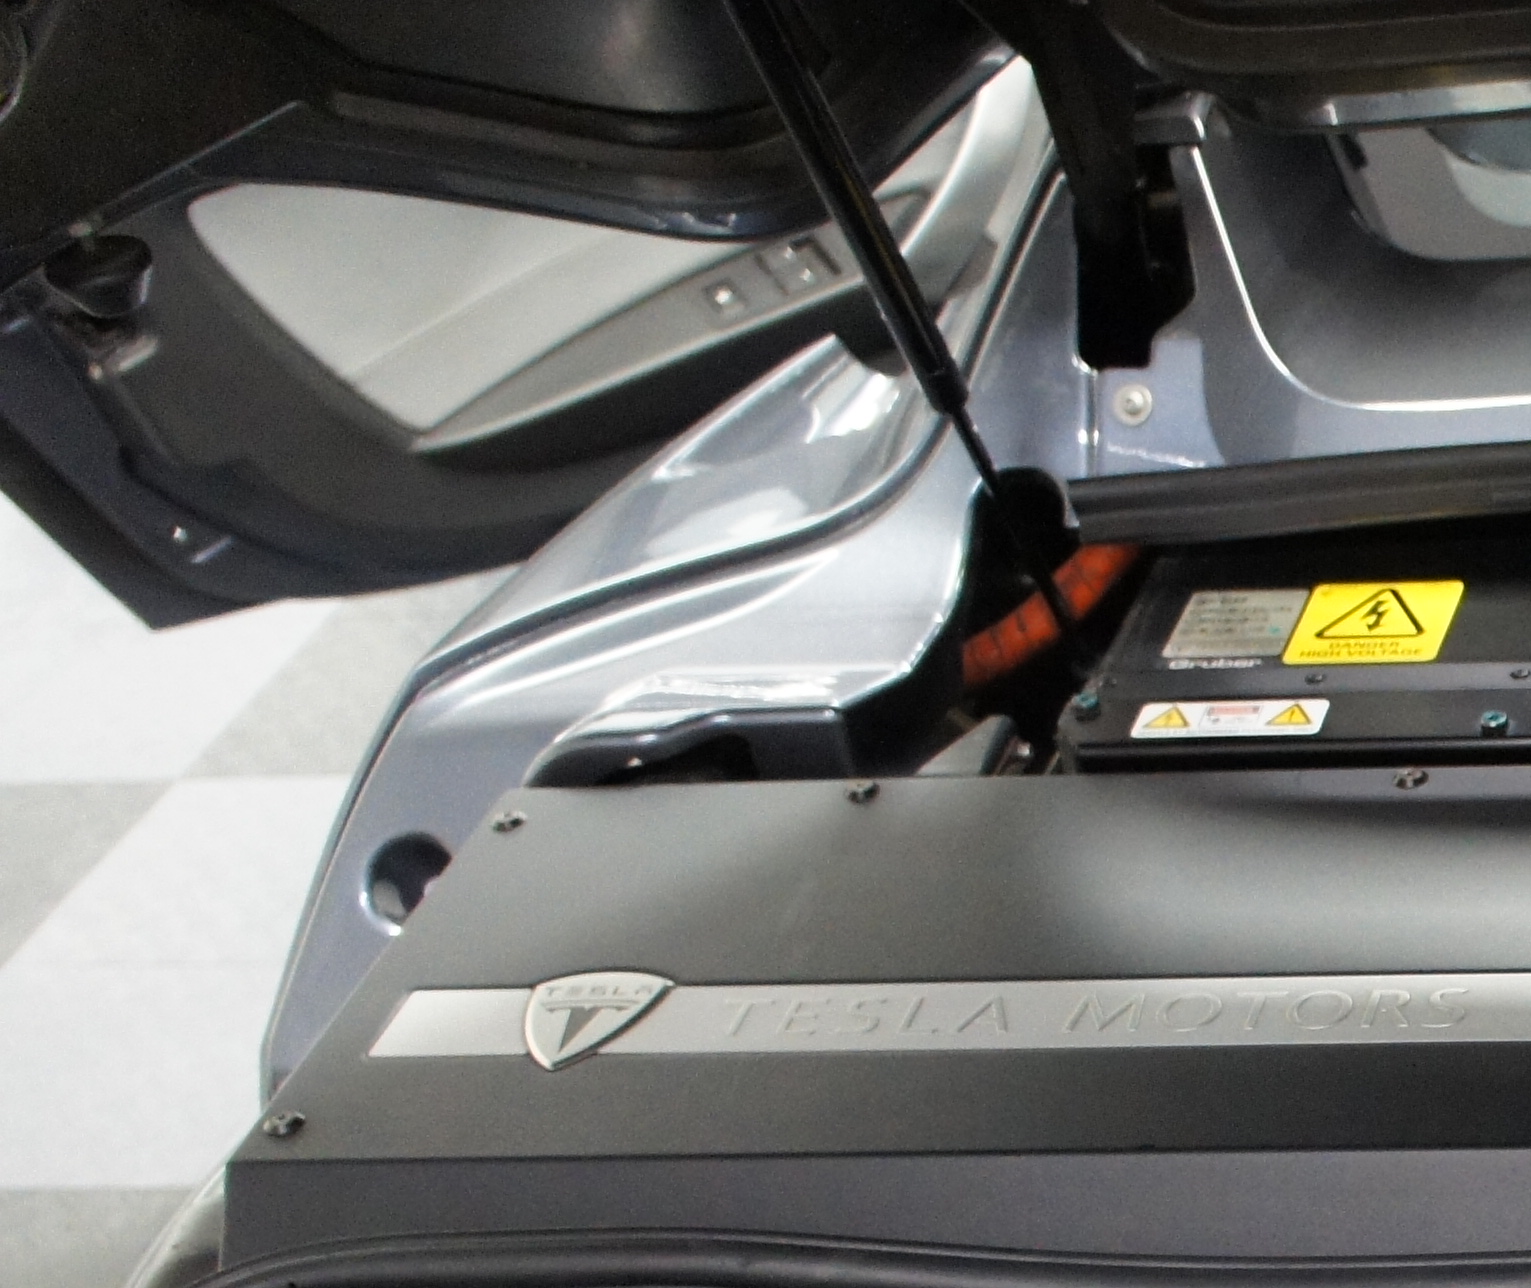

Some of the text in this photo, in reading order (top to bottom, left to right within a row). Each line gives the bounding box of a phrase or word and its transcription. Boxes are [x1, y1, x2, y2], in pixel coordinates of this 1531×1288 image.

[1328, 641, 1400, 650] DANGER
[544, 984, 656, 997] TESLA
[724, 987, 1469, 1037] TESLA MOTORS
